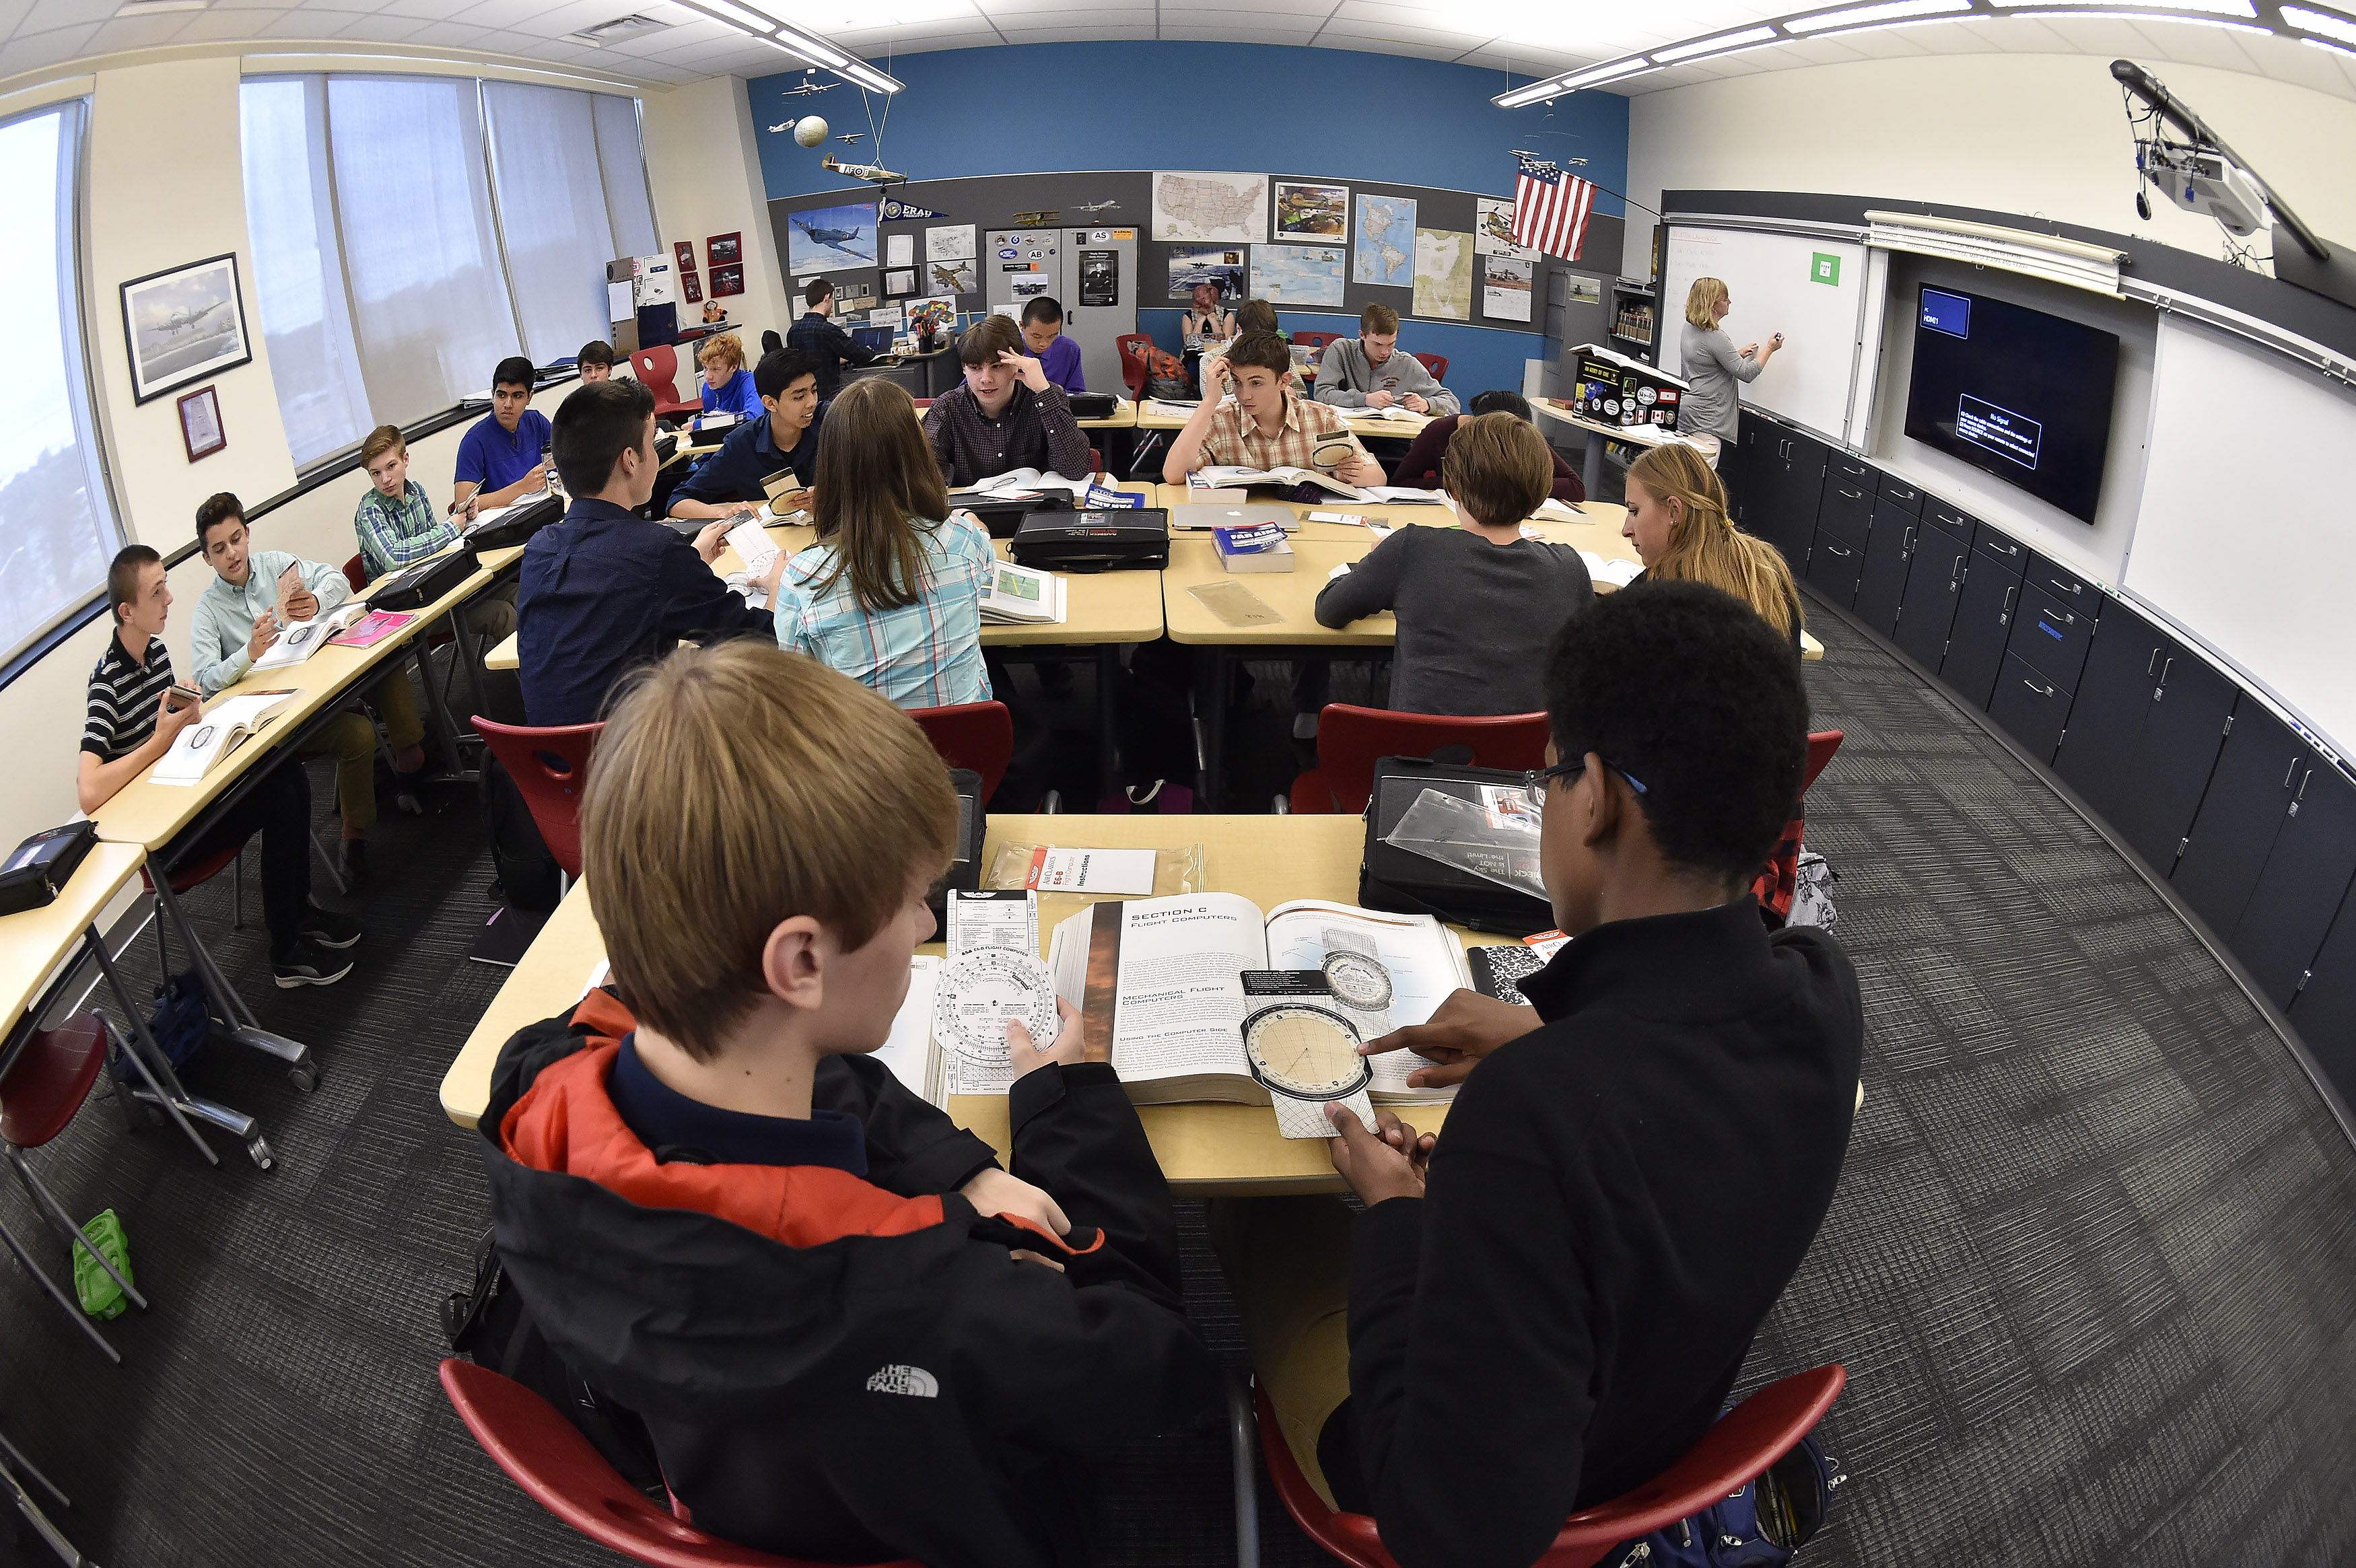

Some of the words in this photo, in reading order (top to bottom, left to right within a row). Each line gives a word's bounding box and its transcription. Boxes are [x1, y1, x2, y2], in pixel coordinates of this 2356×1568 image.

[902, 205, 932, 216] ERAU
[1089, 499, 1111, 507] AIM
[1253, 528, 1277, 537] AIM
[1077, 854, 1090, 886] Instructions
[1474, 865, 1488, 874] Sky
[1132, 908, 1192, 921] SECTION
[1003, 946, 1029, 957] COMPUTER
[866, 1382, 908, 1394] FACE
